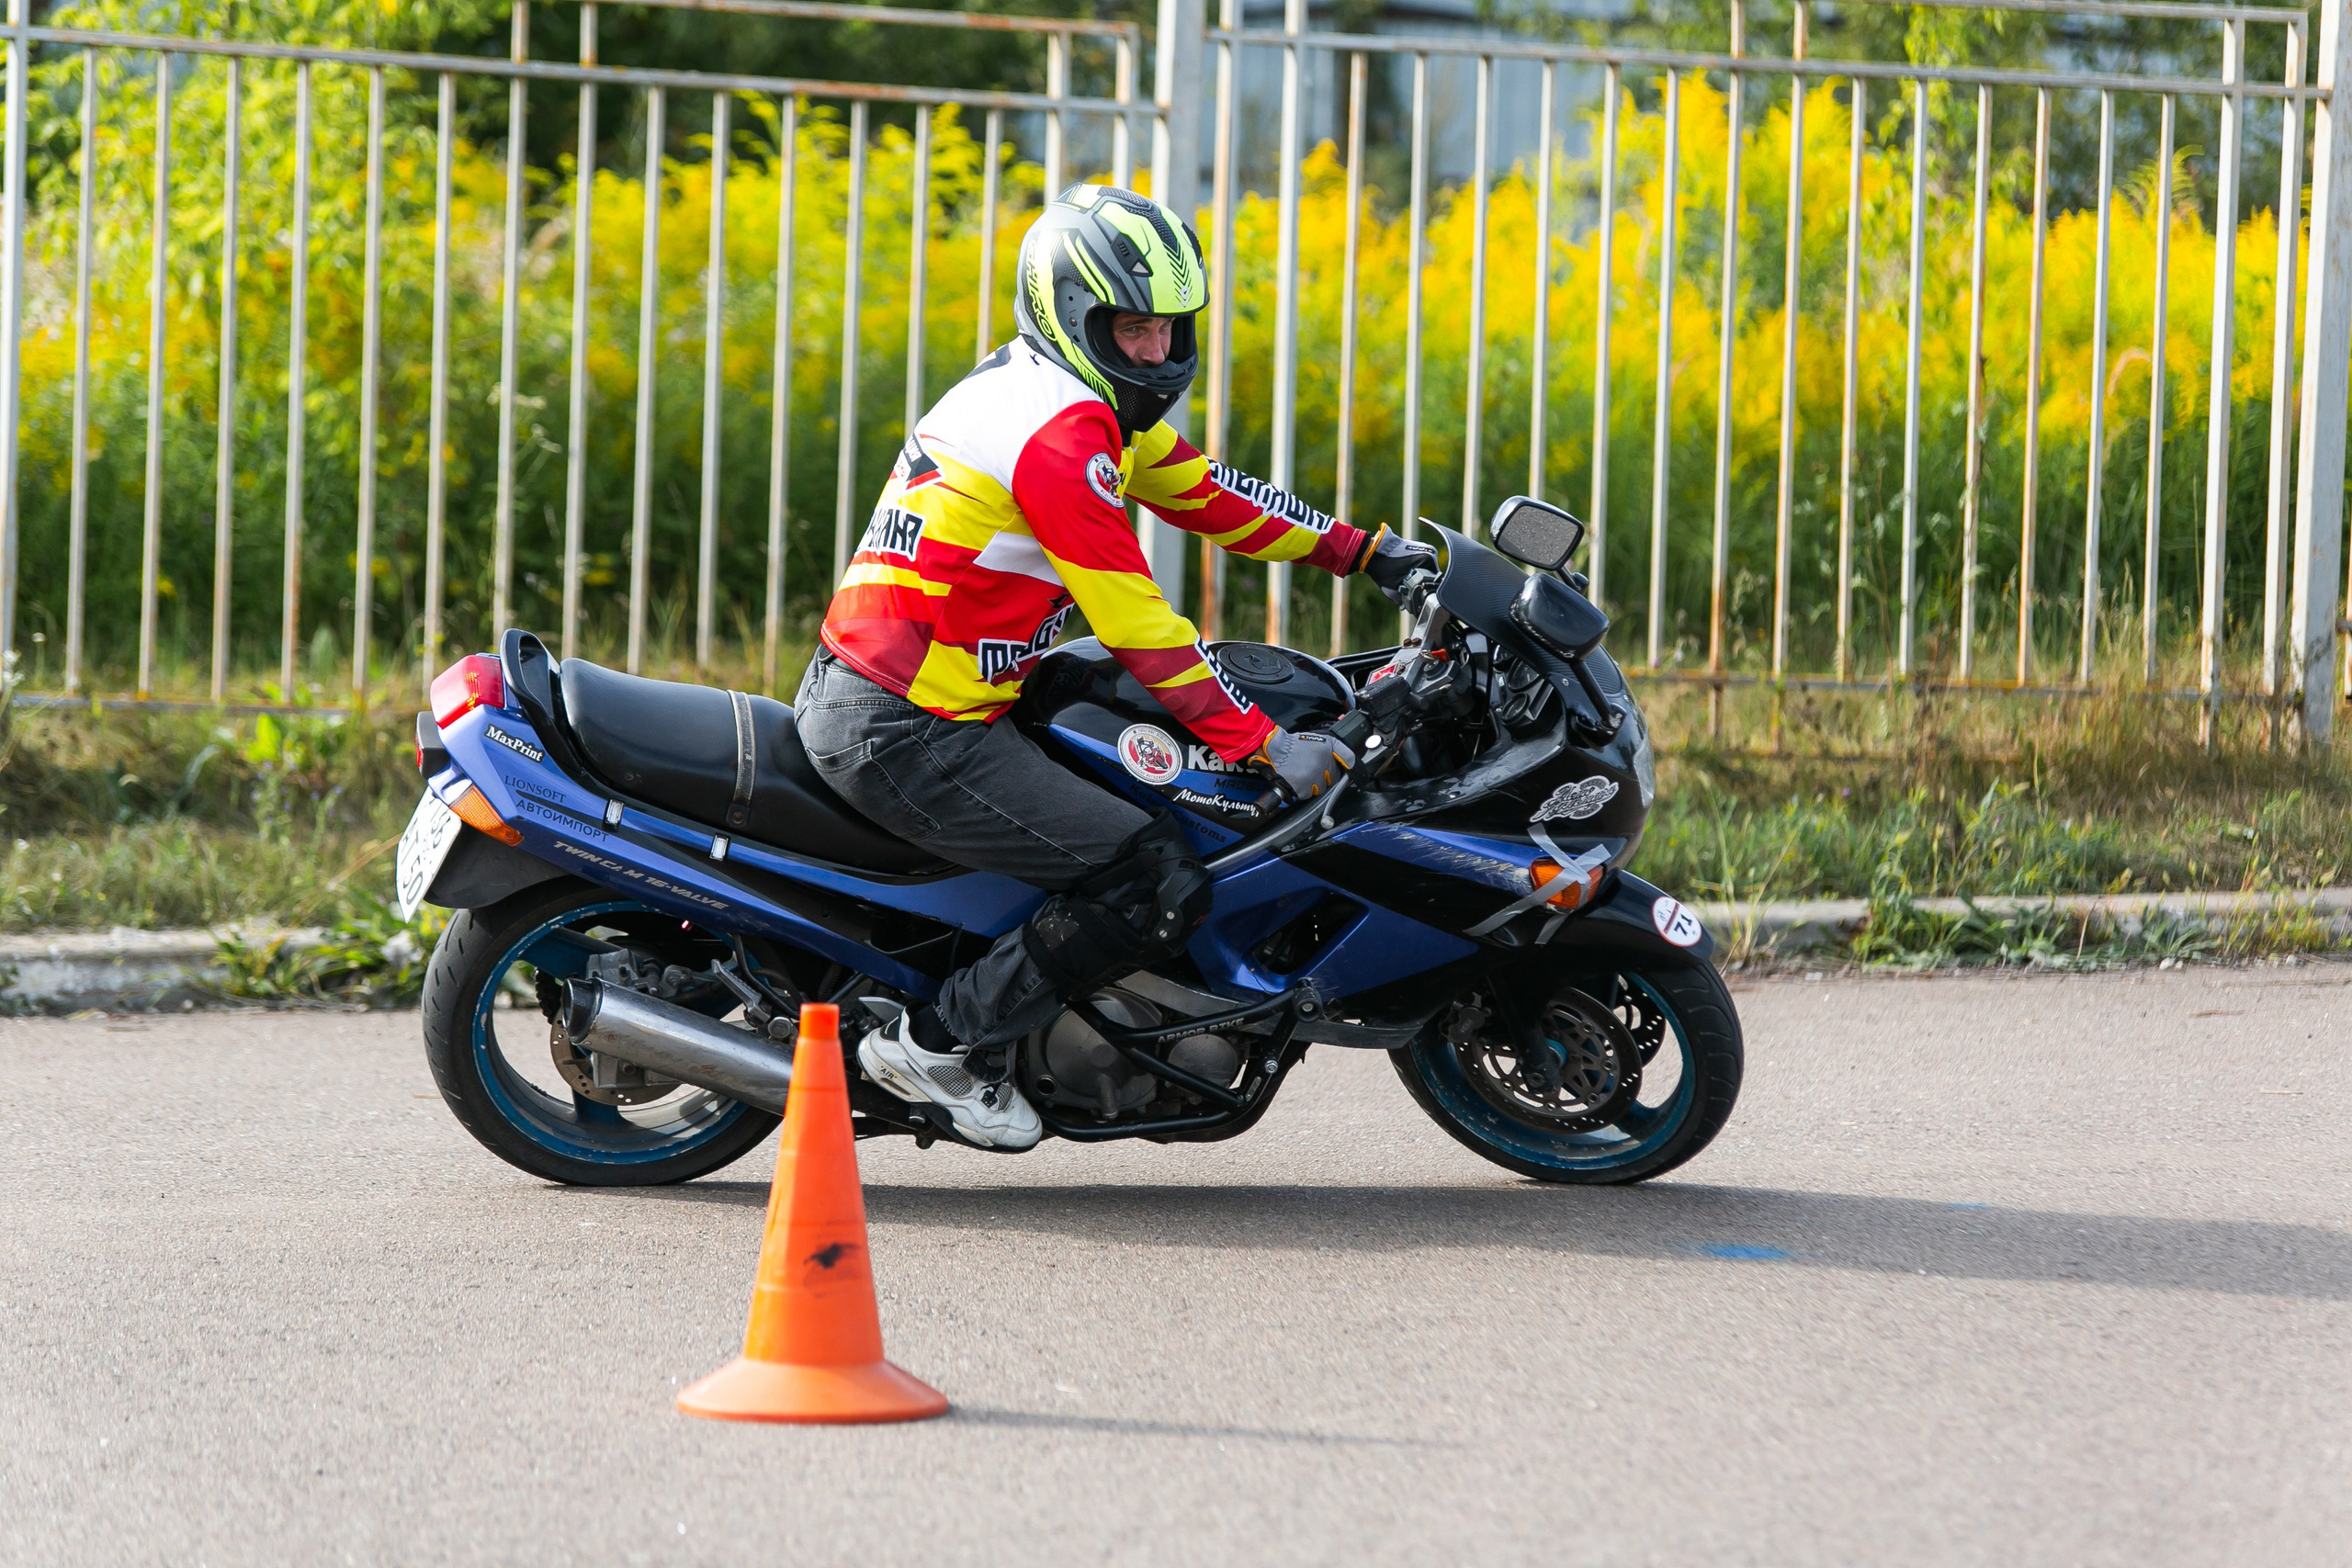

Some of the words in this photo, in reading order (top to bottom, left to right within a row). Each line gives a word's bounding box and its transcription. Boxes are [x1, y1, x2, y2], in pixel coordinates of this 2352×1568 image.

[1026, 240, 1057, 342] SHIRO
[486, 726, 544, 761] MaxPrint
[504, 775, 566, 803] LIONSOFT
[515, 799, 609, 842] АВТОИМПОРТ
[553, 840, 603, 863] TWIN
[598, 860, 645, 879] CAM
[645, 876, 729, 909] 16-VALVE
[1674, 913, 1693, 936] 71
[1158, 1027, 1206, 1043] ARMOR
